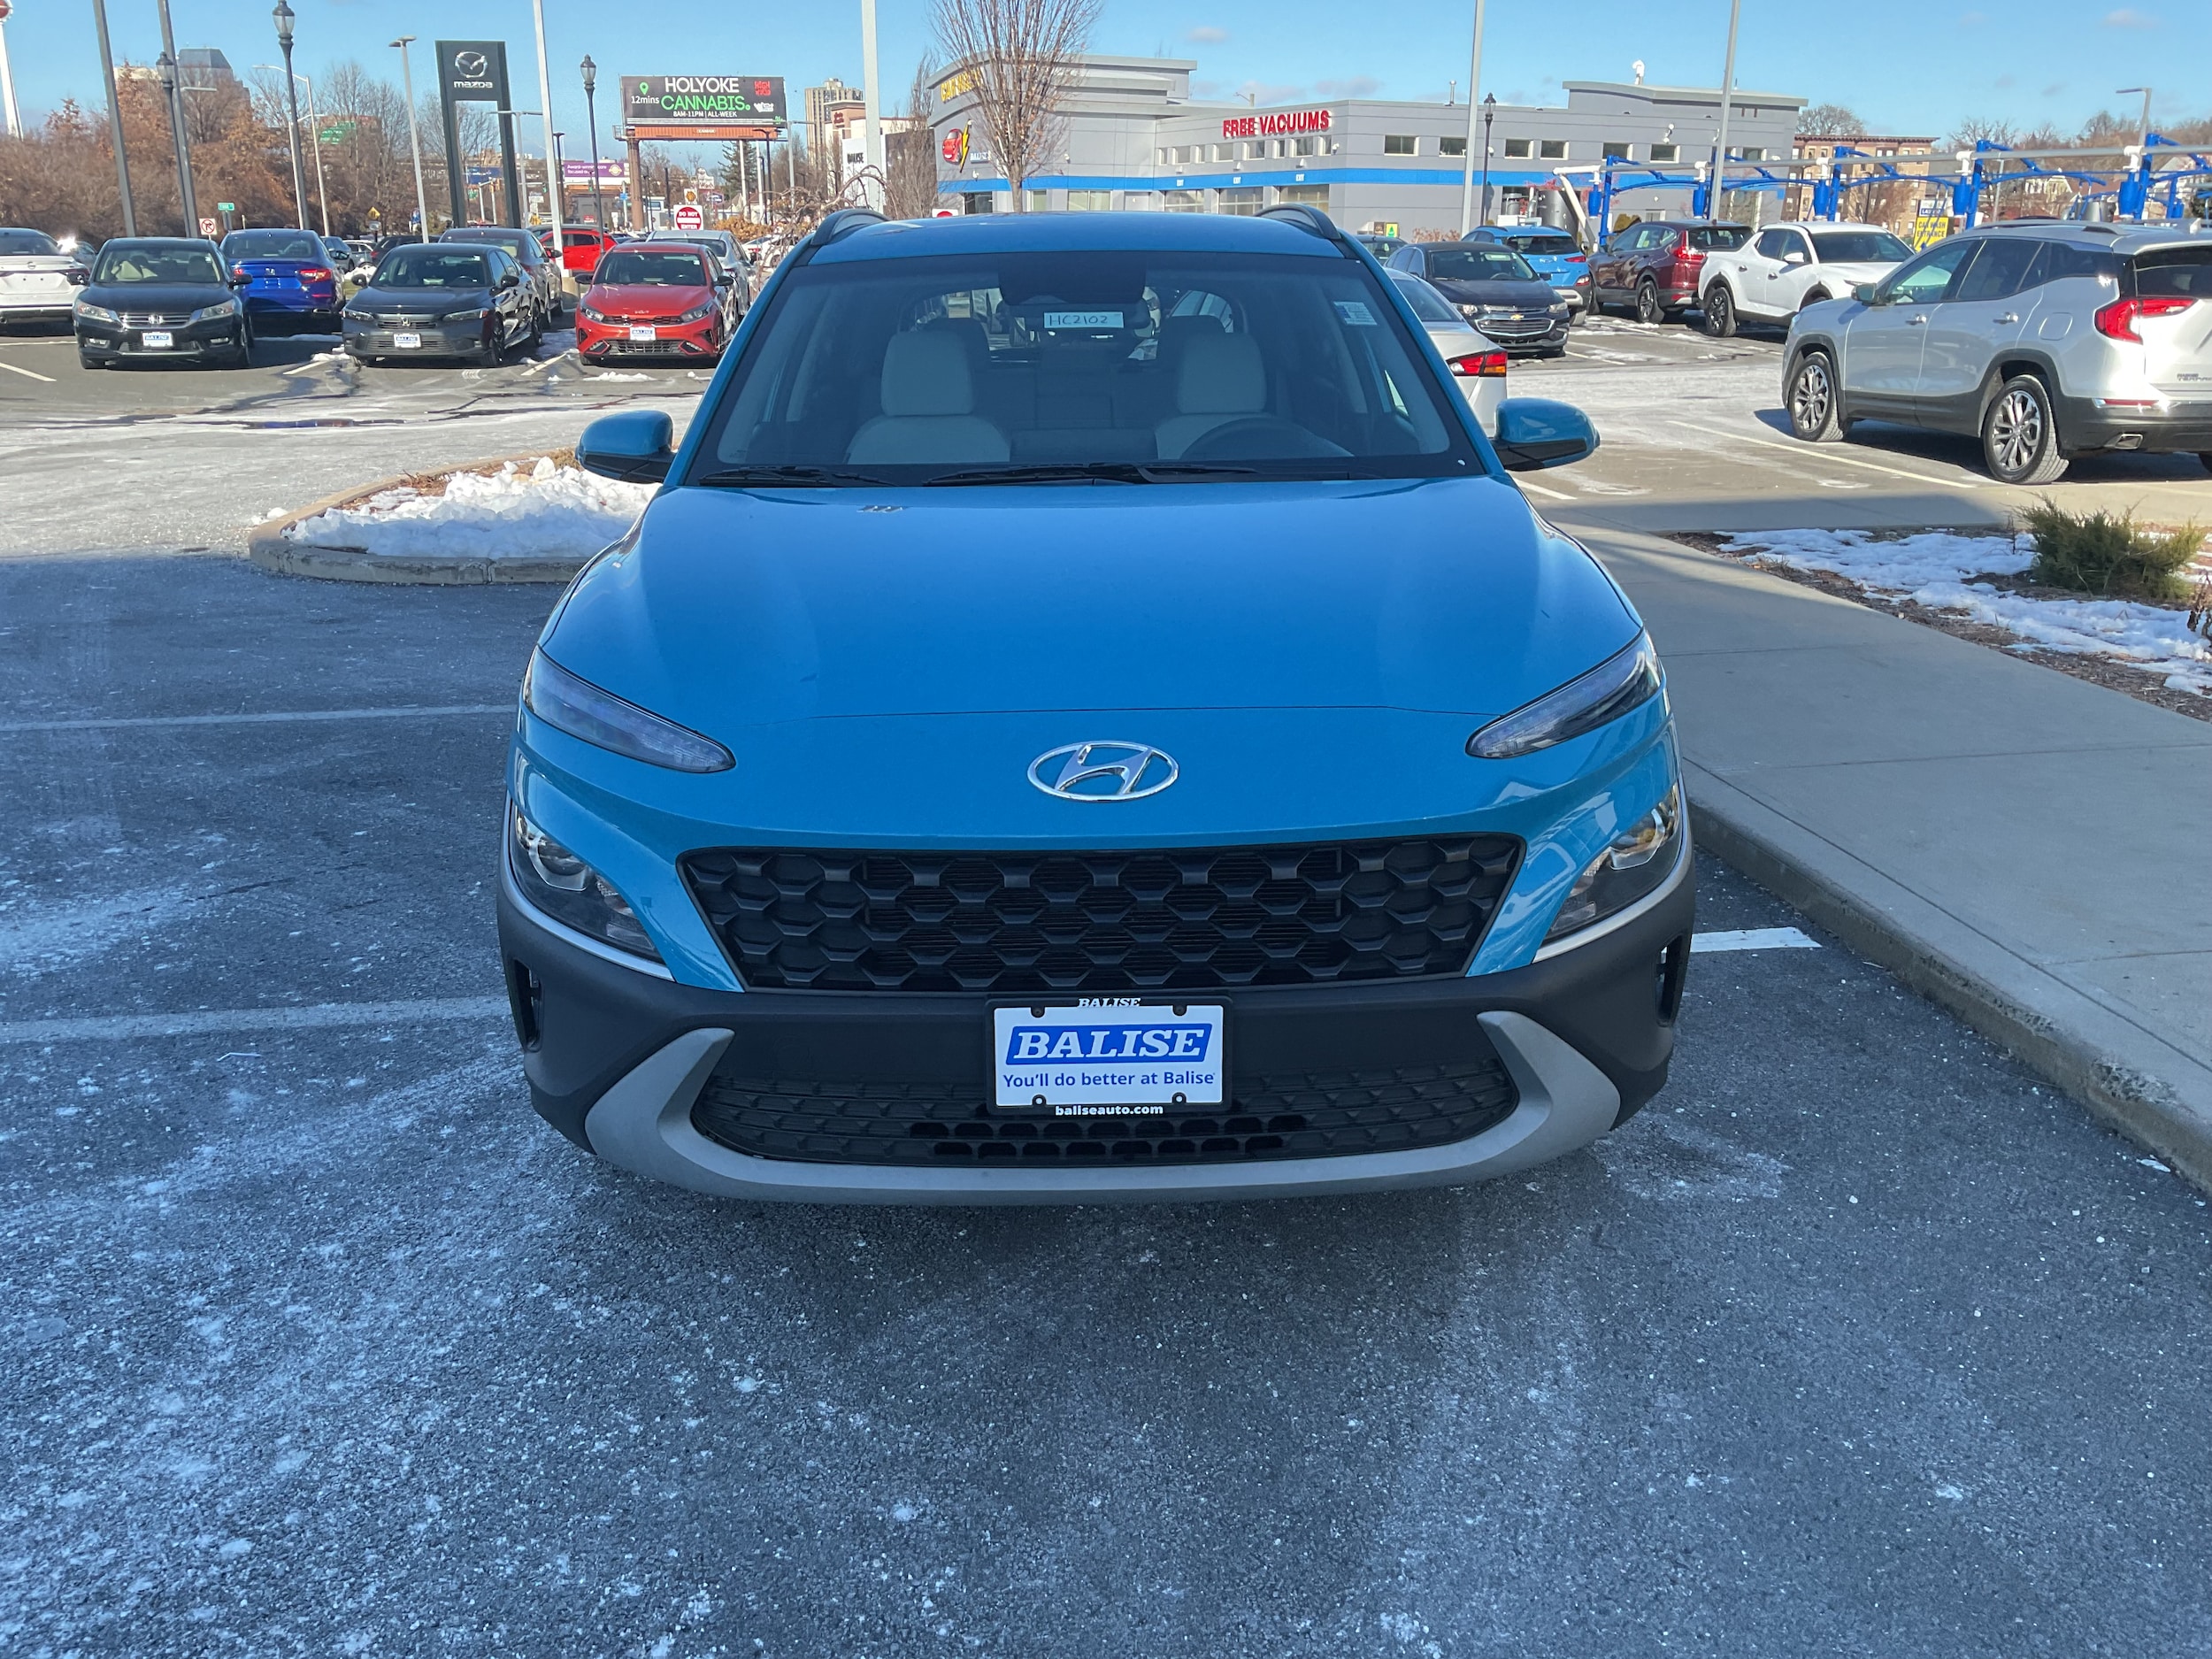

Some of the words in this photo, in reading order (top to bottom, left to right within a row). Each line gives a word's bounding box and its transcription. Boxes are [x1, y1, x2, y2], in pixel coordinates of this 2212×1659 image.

[664, 77, 740, 93] HOLYOKE
[631, 96, 660, 104] 12mins
[1222, 118, 1256, 138] FREE
[1259, 110, 1331, 134] VACUUMS
[1049, 314, 1108, 326] HC2102
[1078, 998, 1141, 1008] BALISE
[1013, 1029, 1205, 1059] BALISE
[1003, 1073, 1048, 1087] You'll
[1055, 1072, 1076, 1087] do
[1081, 1071, 1136, 1086] better
[1141, 1072, 1158, 1085] at
[1164, 1071, 1214, 1085] Balise
[1056, 1105, 1164, 1116] baliseauto.com
